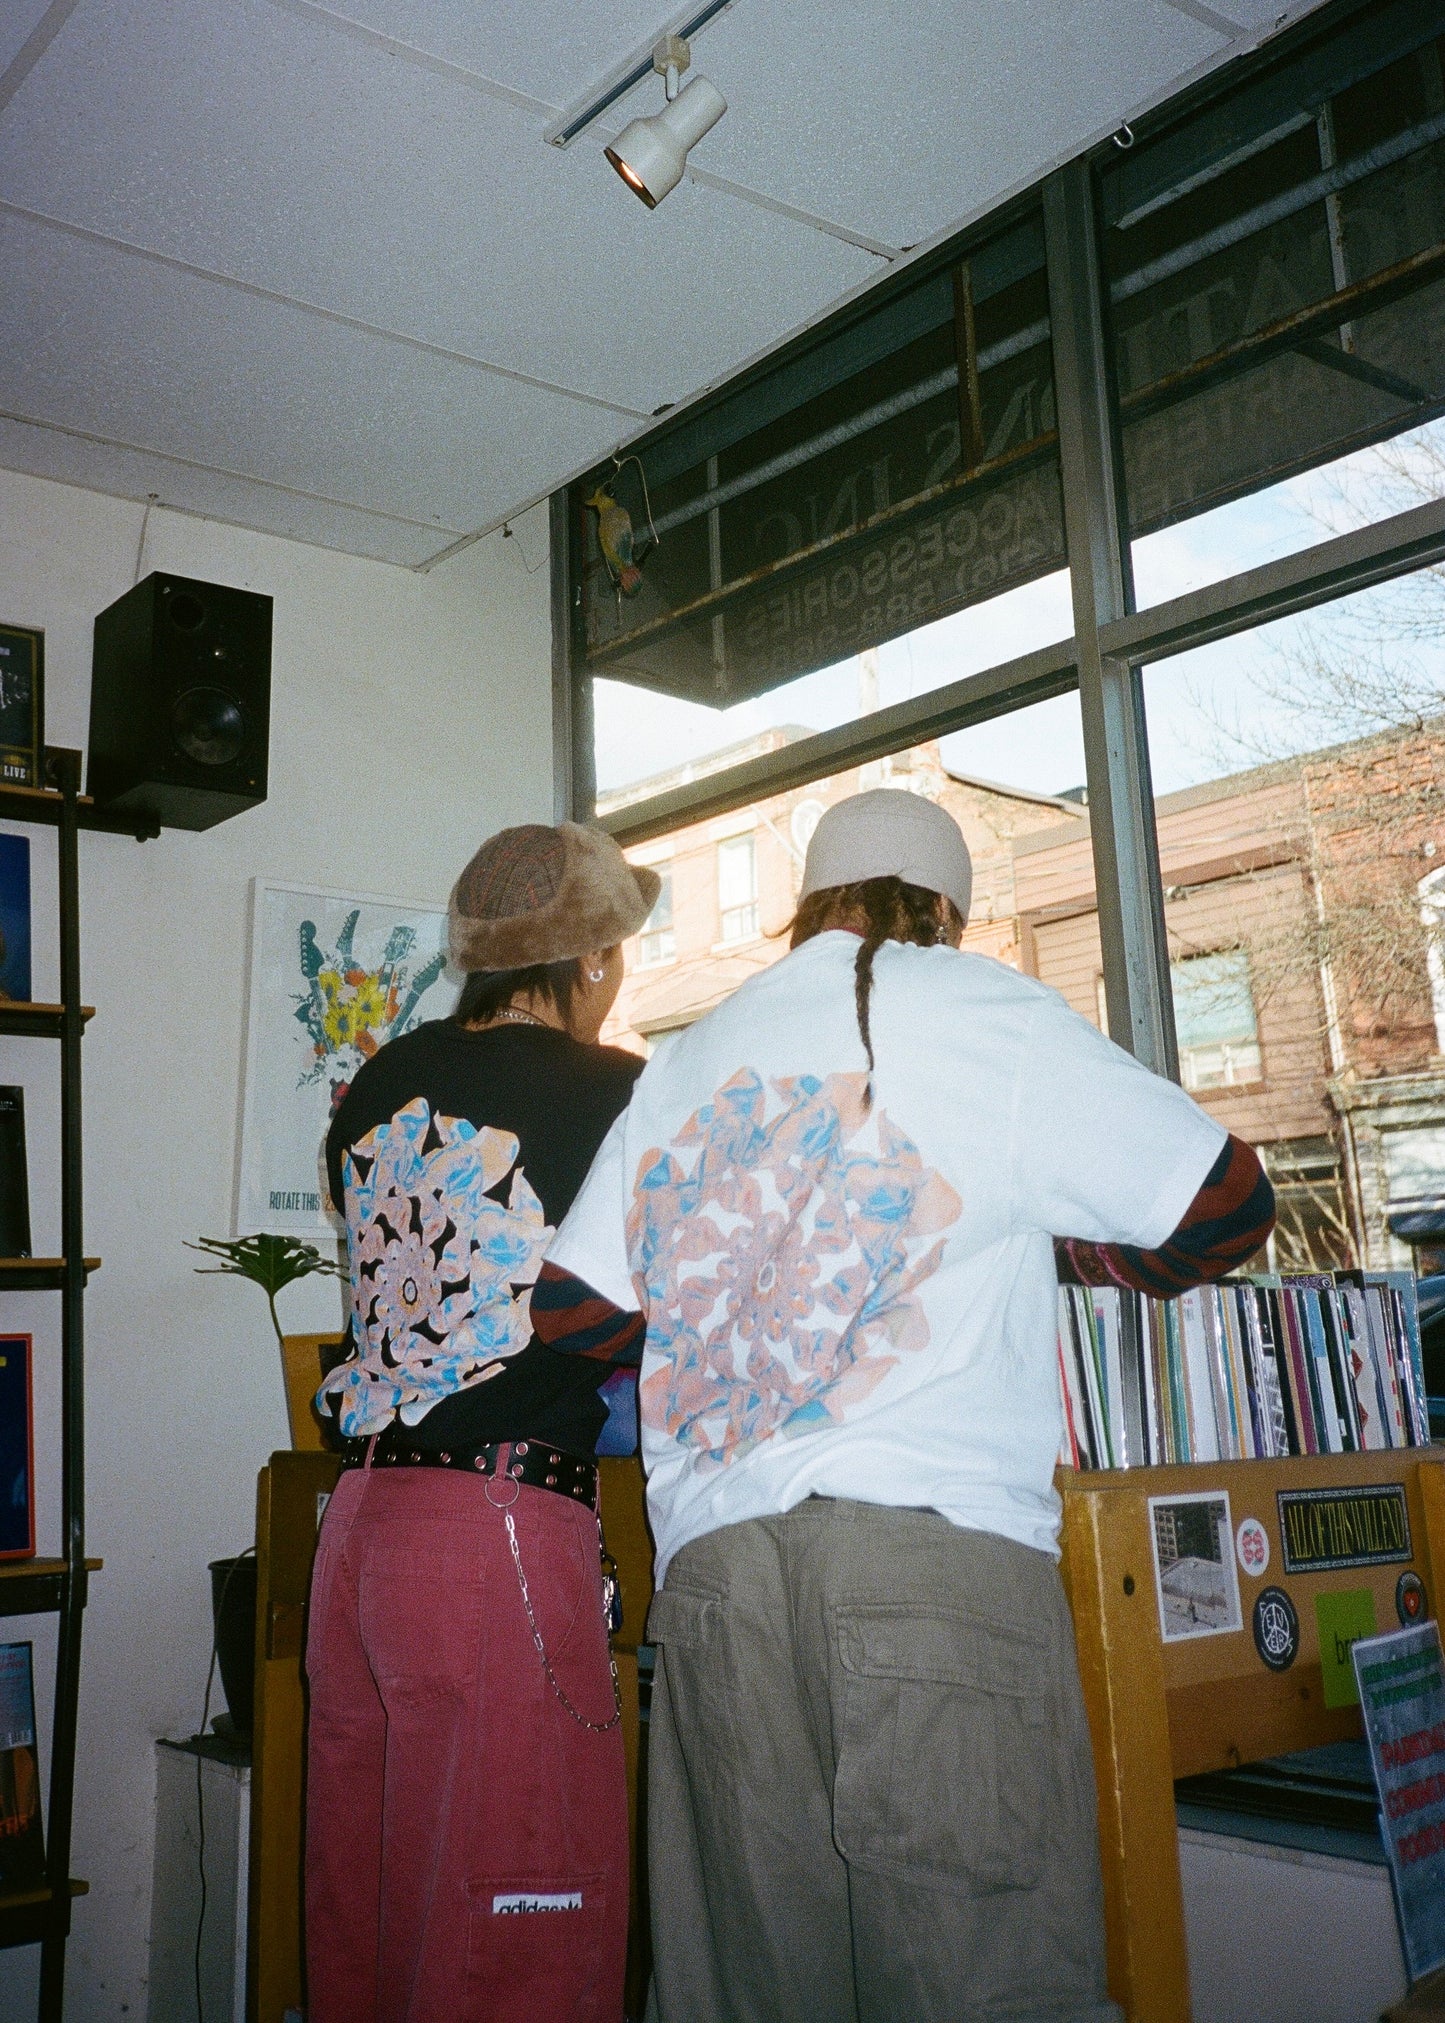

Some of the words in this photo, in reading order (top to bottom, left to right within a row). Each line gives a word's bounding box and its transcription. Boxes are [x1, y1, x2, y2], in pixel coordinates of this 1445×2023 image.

[4, 765, 26, 779] LIVE
[269, 1191, 300, 1210] ROTATE
[302, 1193, 320, 1211] THIS
[1287, 1504, 1312, 1559] ALL
[1309, 1503, 1325, 1557] OF
[1325, 1501, 1353, 1555] THIS
[1350, 1499, 1383, 1552] WILL
[1380, 1498, 1405, 1550] END
